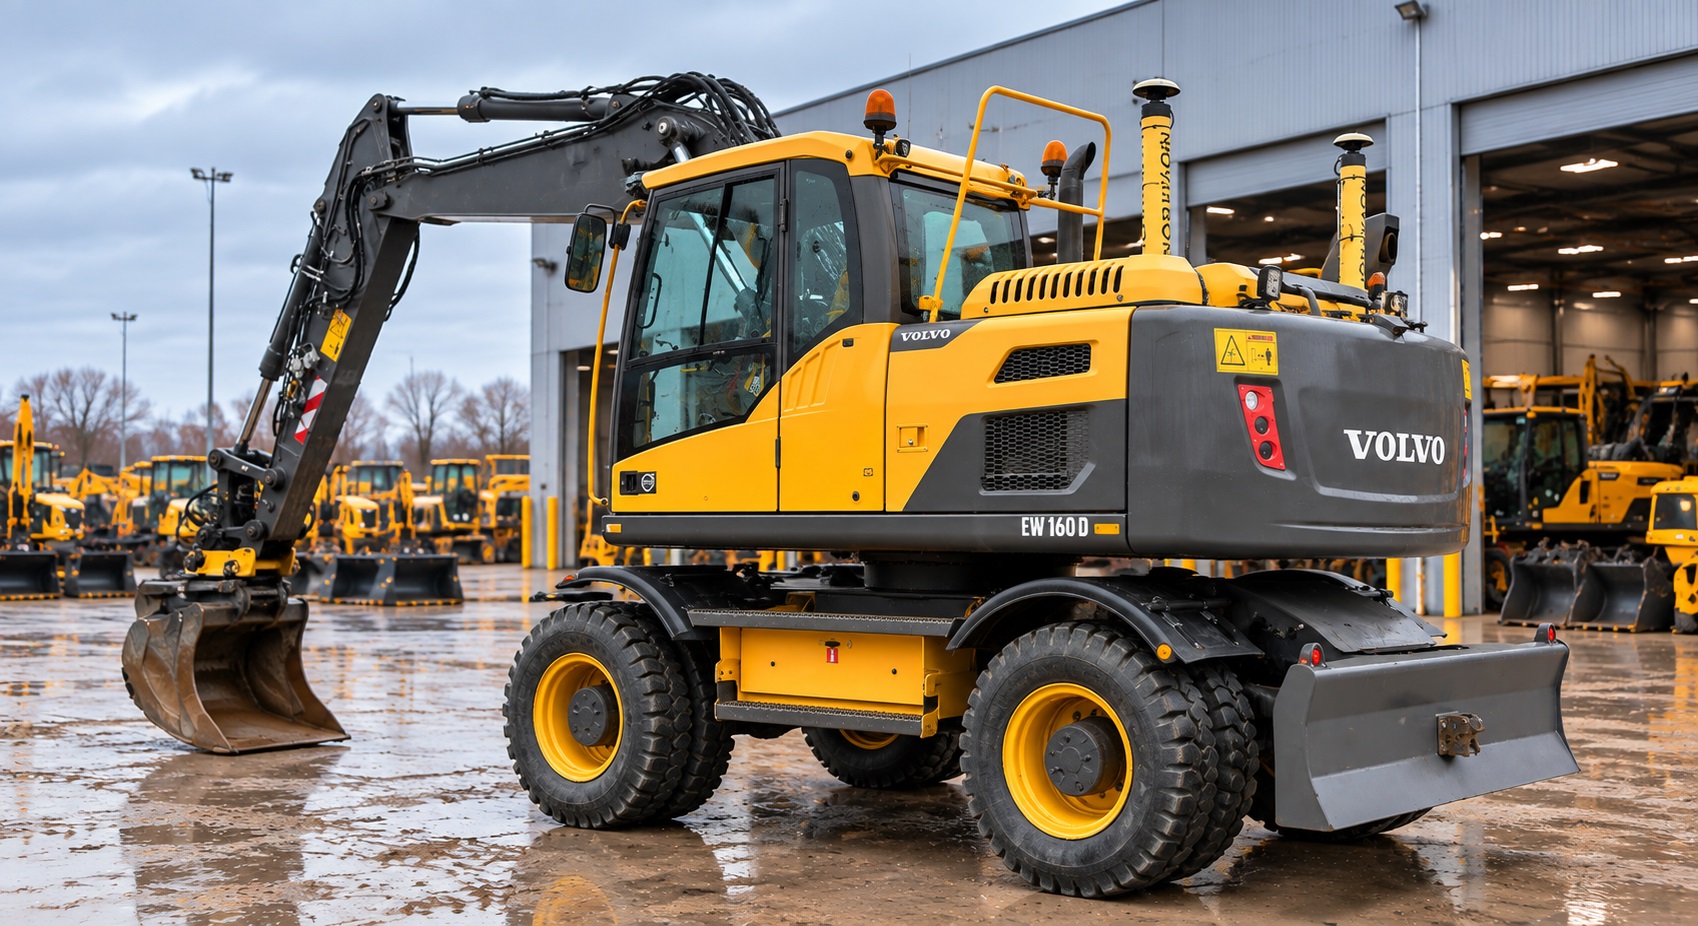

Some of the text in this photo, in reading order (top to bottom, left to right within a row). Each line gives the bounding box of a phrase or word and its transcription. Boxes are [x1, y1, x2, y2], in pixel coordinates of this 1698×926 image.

[901, 328, 950, 342] VOLVO
[1343, 429, 1446, 465] VOLVO
[1021, 516, 1089, 537] EW 160 D
